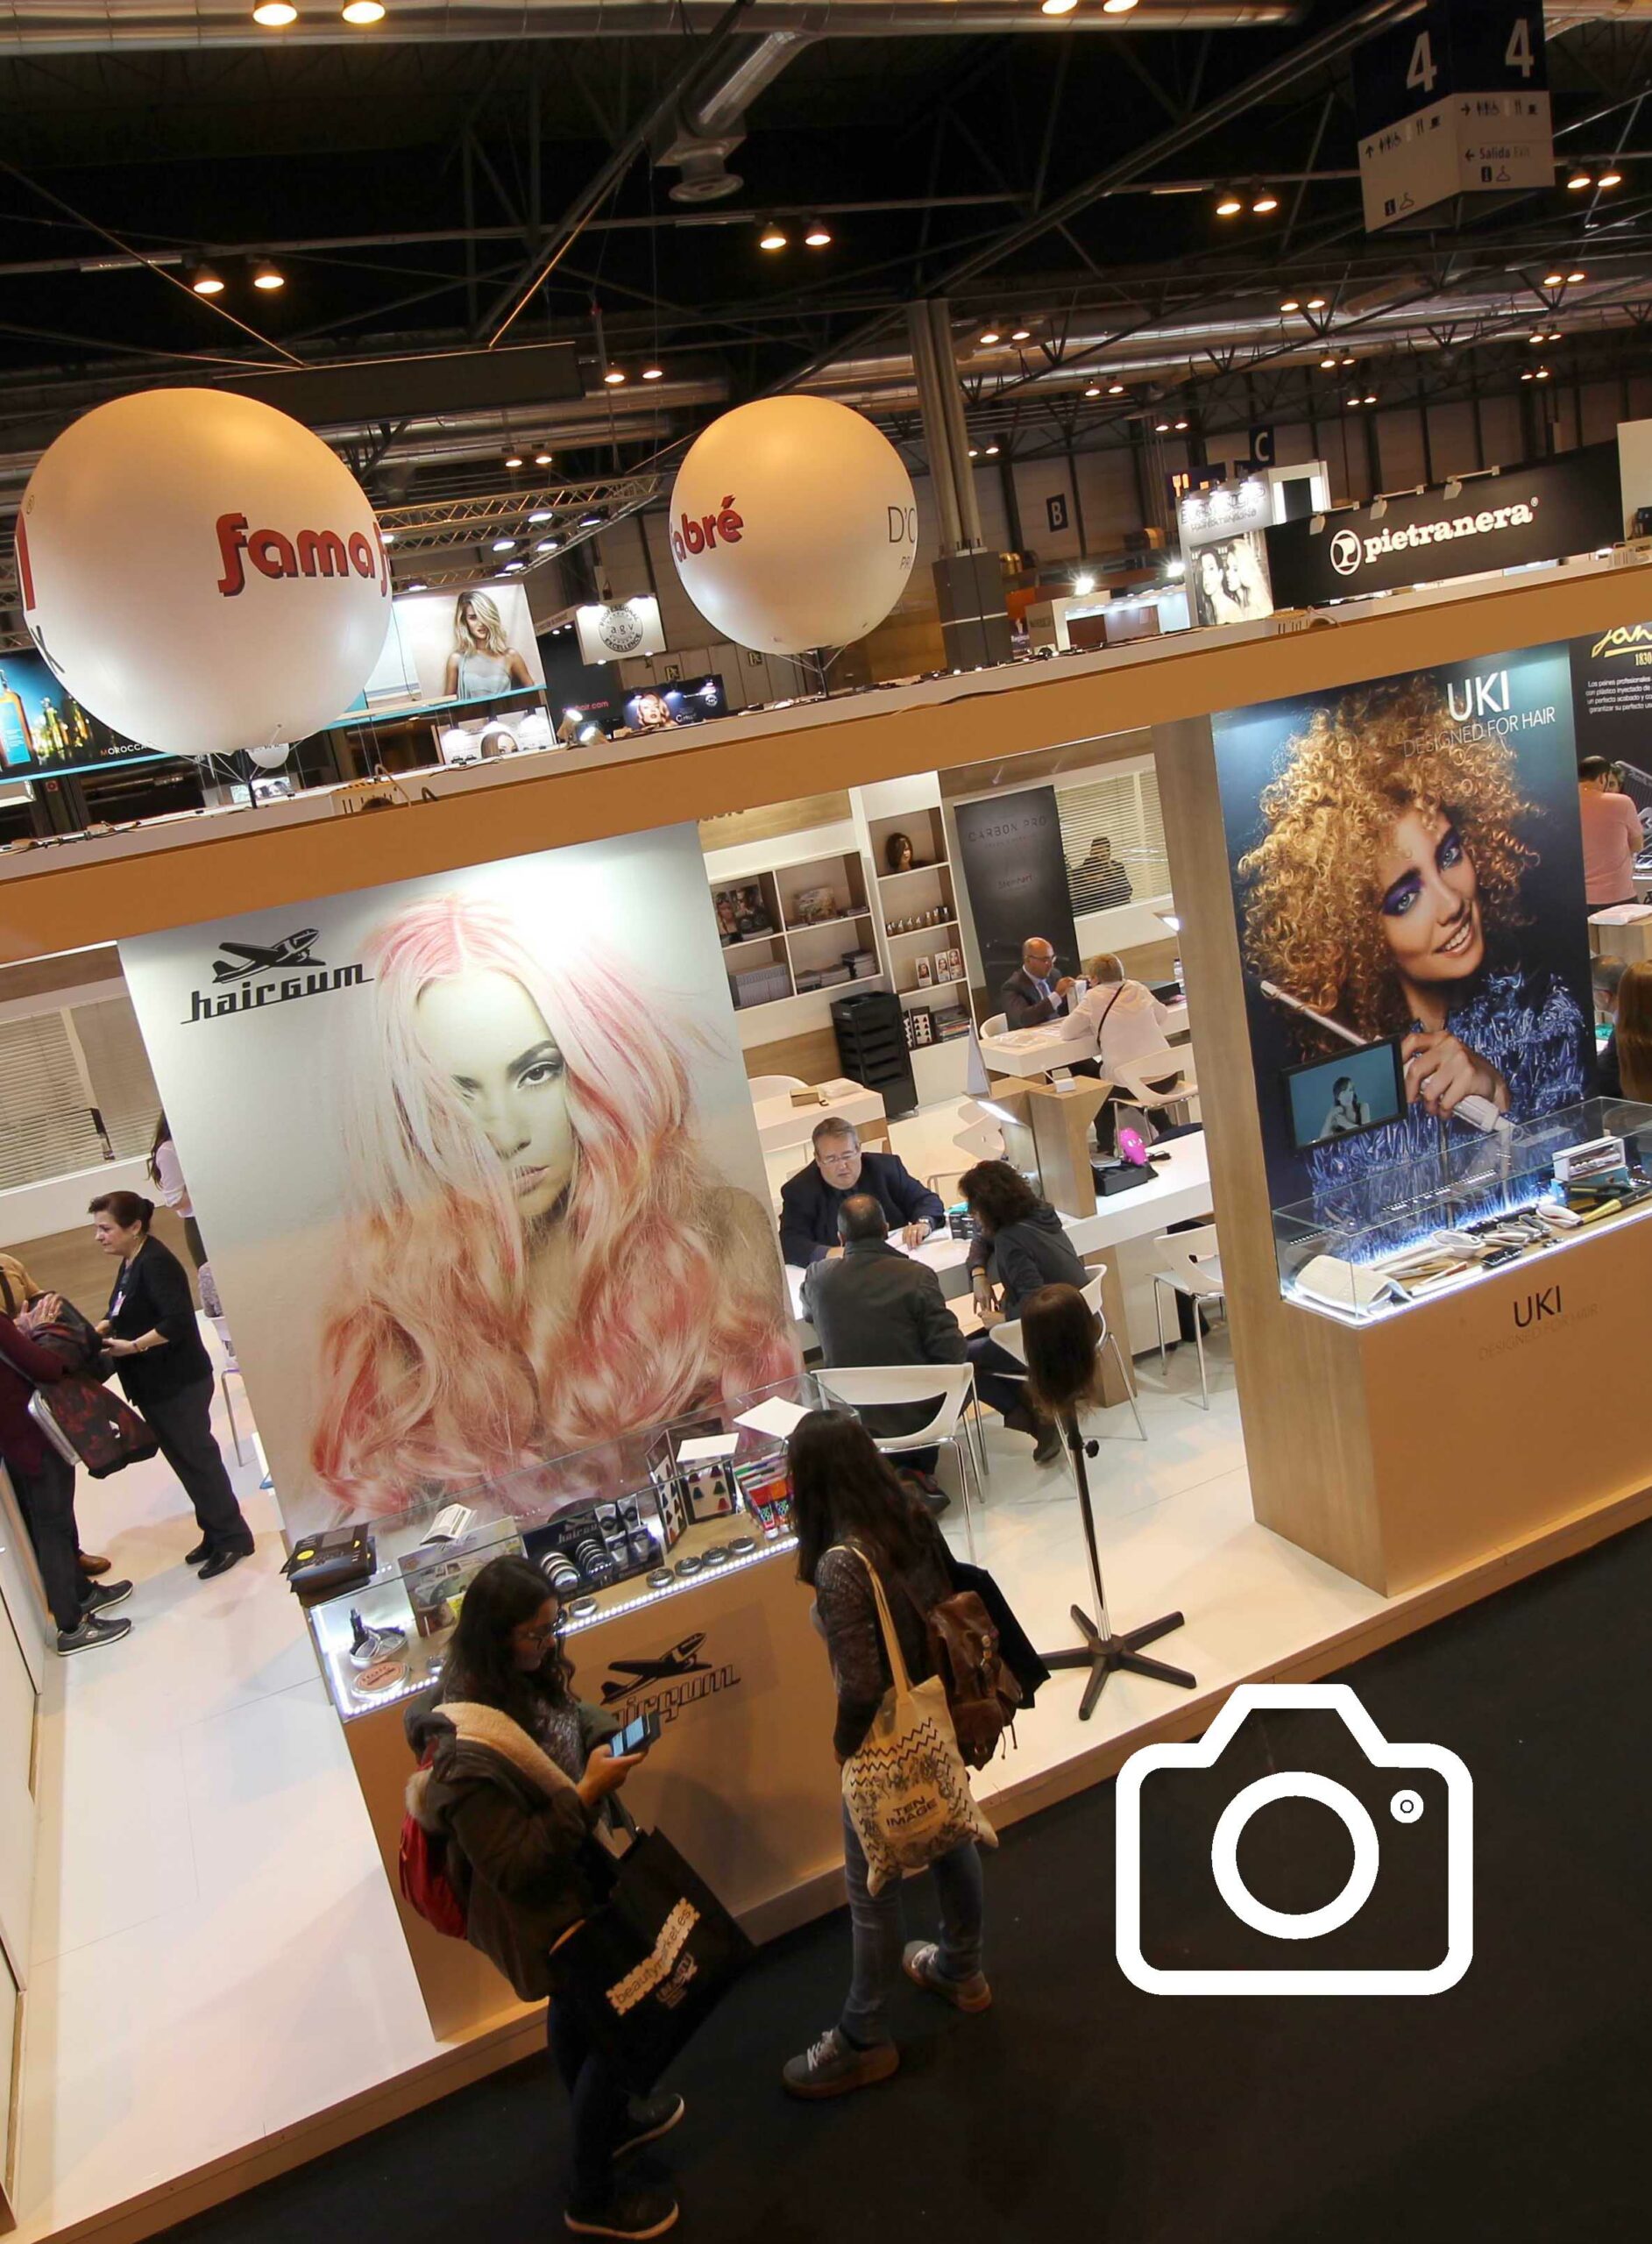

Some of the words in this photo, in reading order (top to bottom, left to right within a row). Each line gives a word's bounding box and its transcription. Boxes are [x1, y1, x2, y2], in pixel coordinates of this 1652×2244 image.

[1407, 31, 1437, 92] 4
[1505, 18, 1534, 77] 4
[1479, 146, 1510, 160] Salida
[1514, 145, 1530, 158] Exit
[1254, 432, 1269, 462] C
[1052, 501, 1063, 525] B
[216, 513, 375, 597] fama
[604, 632, 642, 653] EXCELLENCE
[1447, 671, 1510, 722] UKI
[1404, 723, 1484, 757] DESIGNED
[1487, 715, 1519, 736] FOR
[1522, 707, 1556, 729] HAIR
[1024, 815, 1047, 828] PRO
[1514, 1285, 1562, 1328] UKI
[885, 1798, 938, 1827] IMAGE
[892, 1795, 926, 1816] TEN
